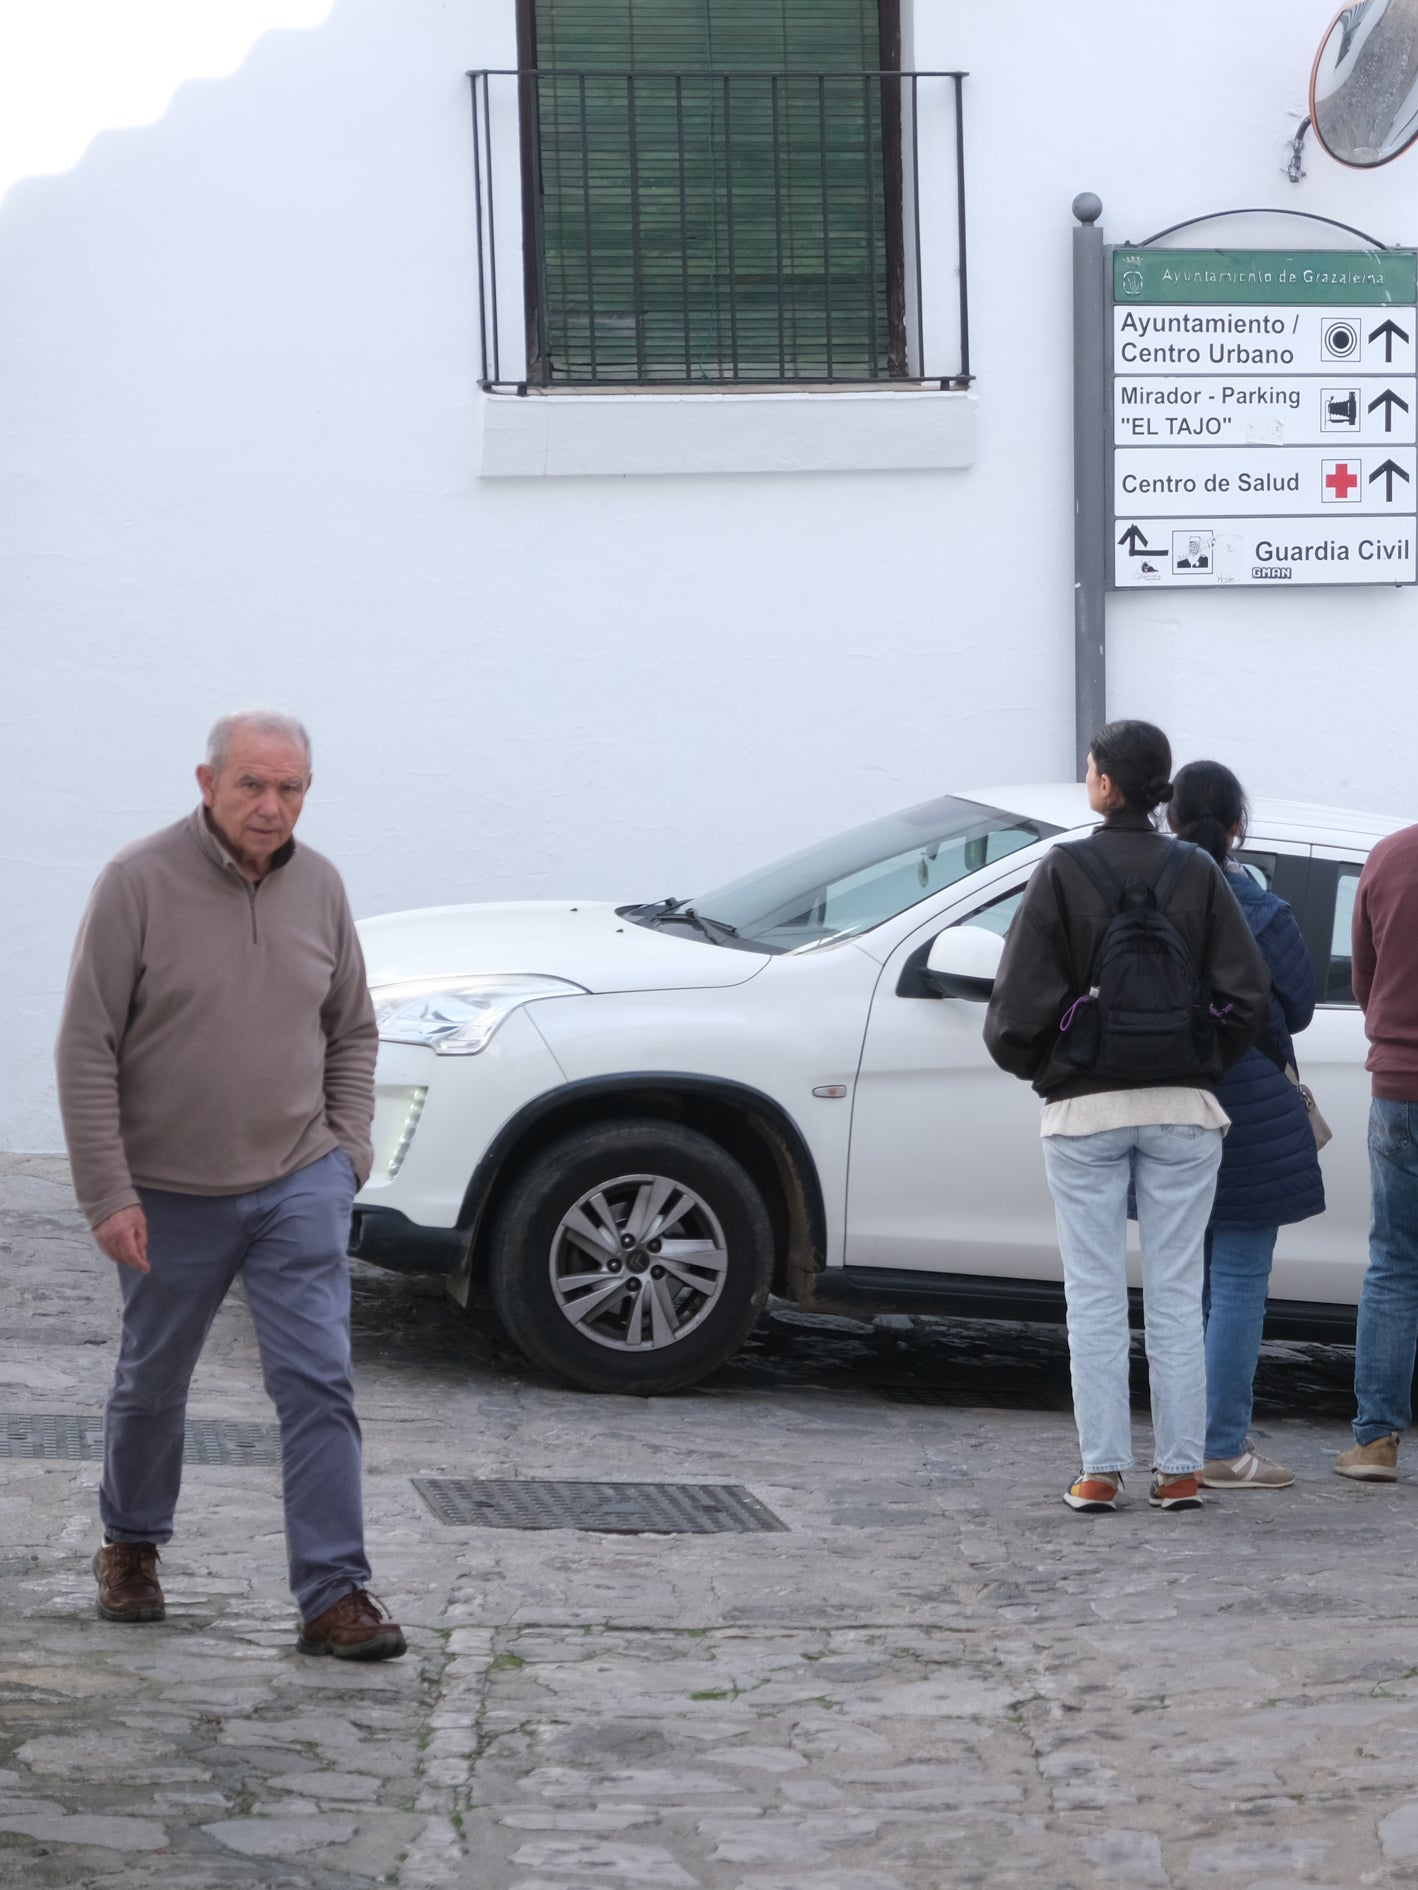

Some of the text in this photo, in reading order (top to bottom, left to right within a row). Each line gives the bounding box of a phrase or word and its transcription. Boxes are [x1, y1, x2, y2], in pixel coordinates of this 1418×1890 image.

[1279, 269, 1297, 283] de
[1303, 269, 1384, 284] Grazalema
[1120, 311, 1299, 338] Ayuntamiento /
[1121, 341, 1294, 364] Centro Urbano
[1121, 386, 1201, 405] Mirador
[1222, 386, 1300, 409] Parking
[1121, 417, 1232, 435] "EL TAJO"
[1122, 472, 1299, 494] Centro de Salud
[1255, 539, 1409, 562] Guardia Civil
[1252, 567, 1292, 579] GMAN
